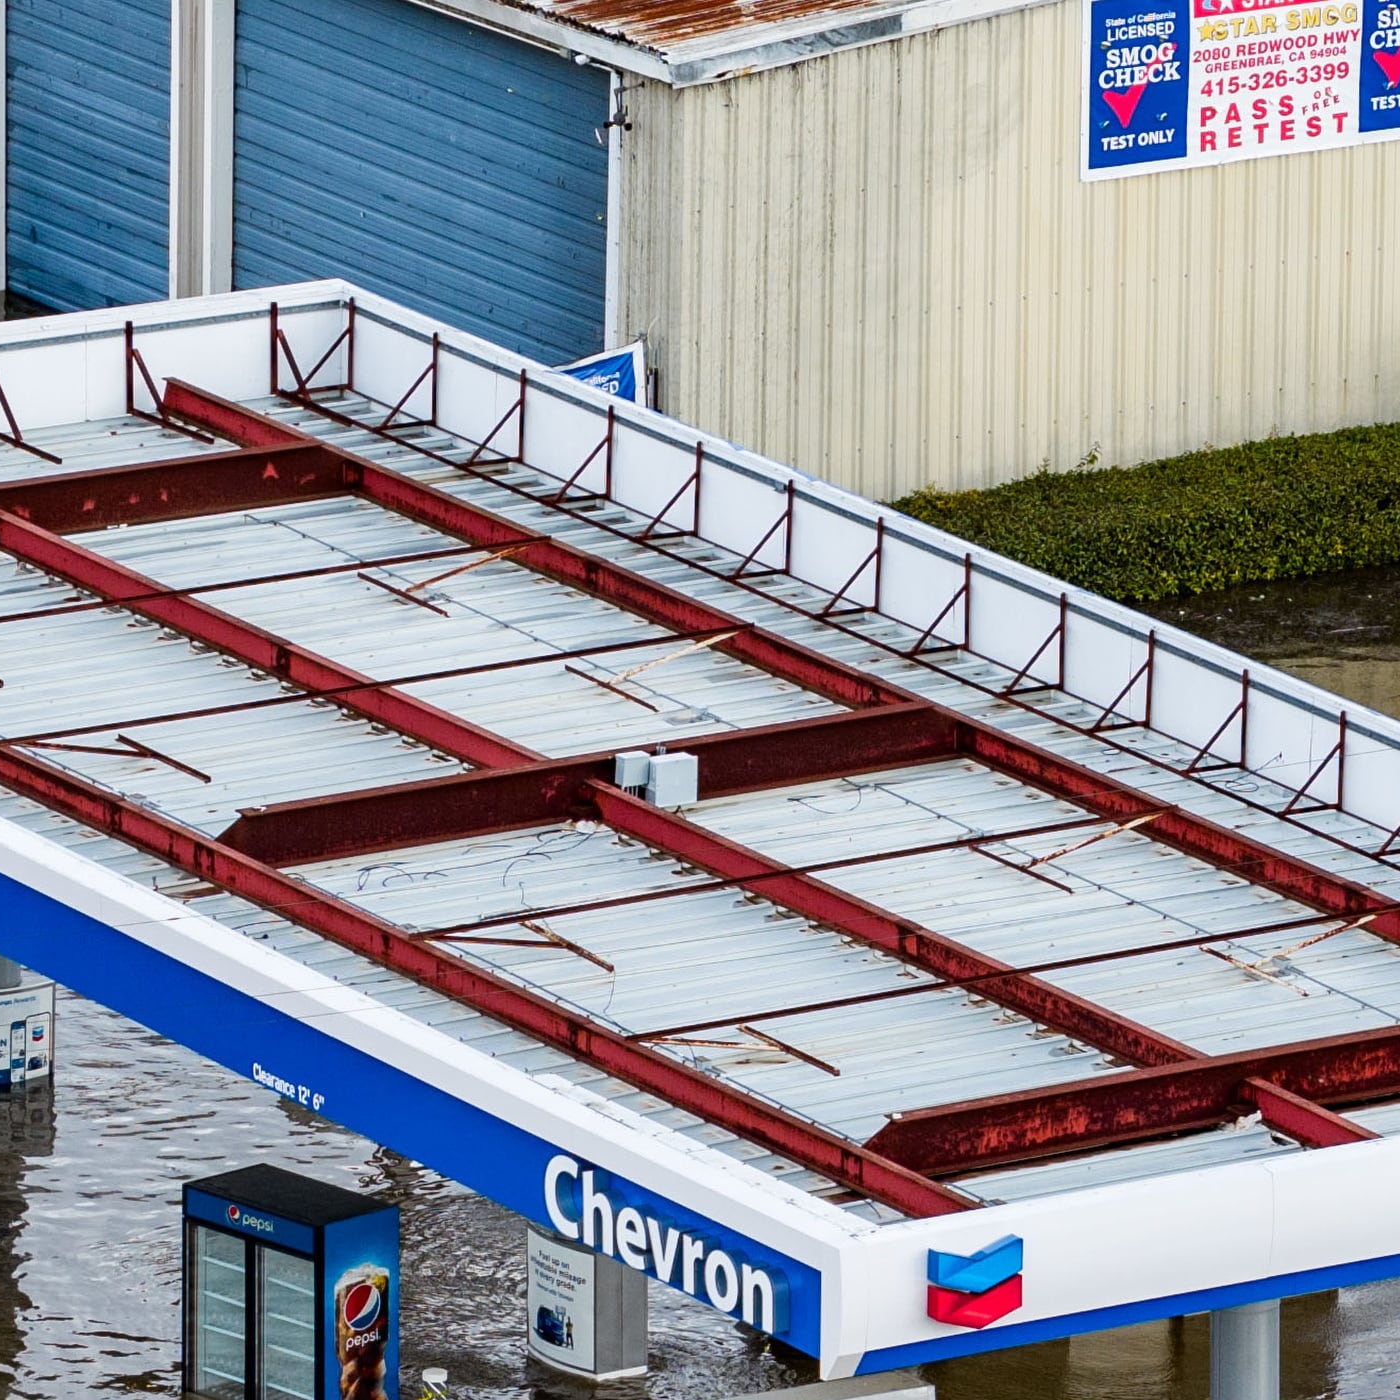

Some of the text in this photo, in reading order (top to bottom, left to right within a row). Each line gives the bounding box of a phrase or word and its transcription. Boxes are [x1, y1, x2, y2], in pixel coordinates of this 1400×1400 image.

[1106, 11, 1176, 27] State of California
[1107, 21, 1175, 42] LICENSED
[1213, 4, 1358, 40] STAR SMOG
[1106, 42, 1176, 68] SMOG
[1193, 29, 1361, 63] 2080 REDWOOD HWY
[1205, 46, 1347, 74] GREENBRAE, CA 94904
[1099, 61, 1181, 89] CHECK
[1200, 61, 1350, 97] 415-326-3399
[1200, 95, 1294, 127] PASS
[1302, 95, 1341, 116] FREE
[1101, 129, 1175, 151] TEST ONLY
[1200, 112, 1348, 152] RETEST
[253, 1062, 296, 1098] Clearance
[298, 1085, 310, 1105] 12'
[242, 1213, 274, 1233] pepsi
[544, 1154, 776, 1335] Chevron
[345, 1327, 380, 1352] pepsi
